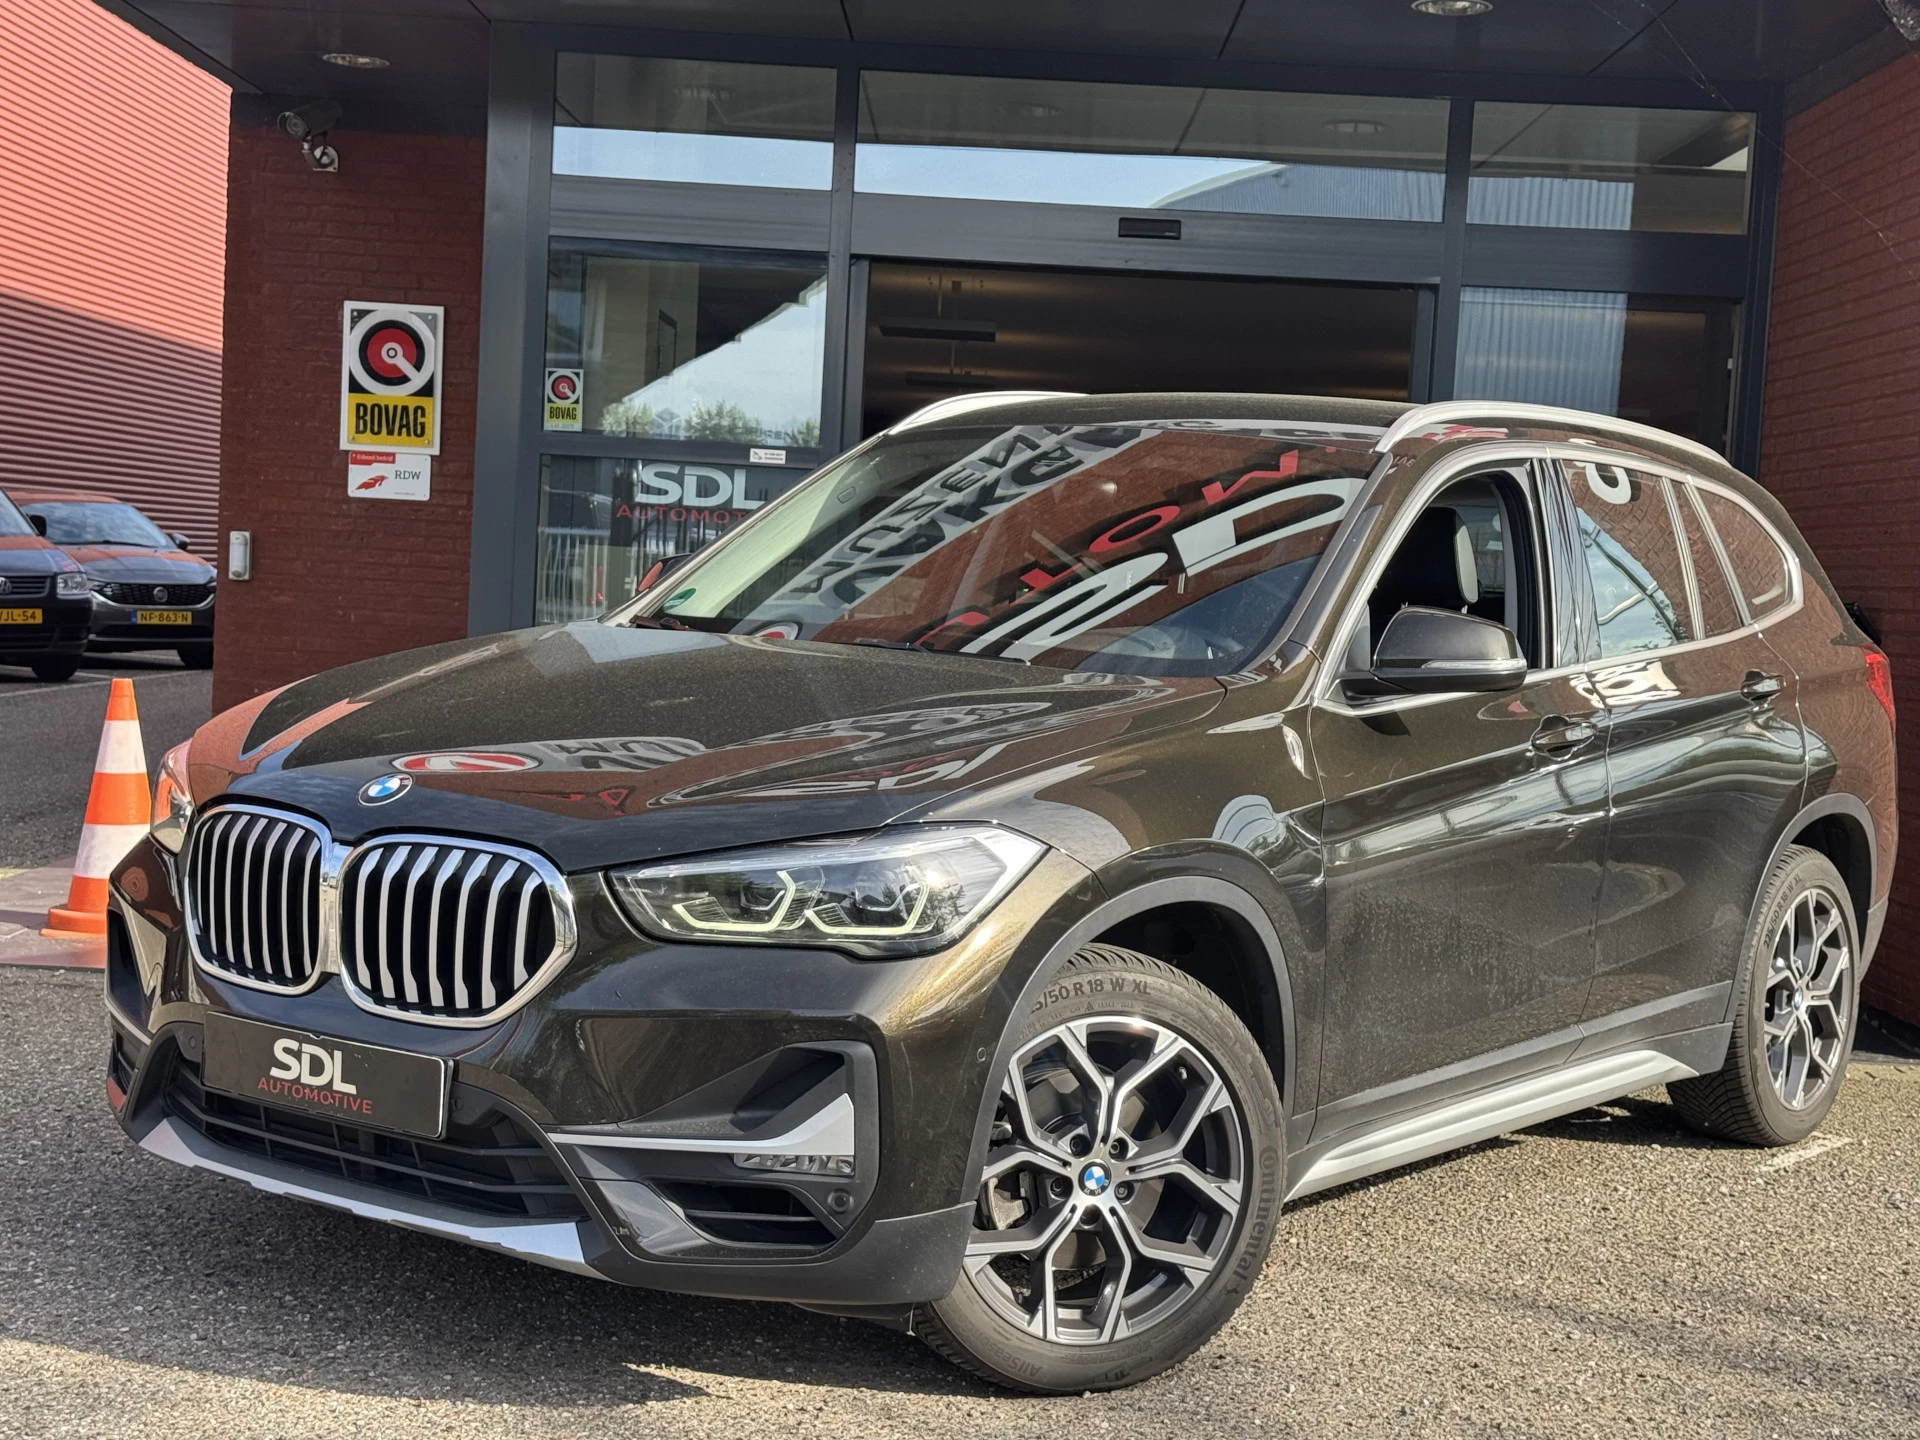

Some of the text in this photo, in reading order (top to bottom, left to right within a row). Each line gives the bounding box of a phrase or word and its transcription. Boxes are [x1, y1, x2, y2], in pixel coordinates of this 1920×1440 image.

[355, 402, 426, 438] BOVAG
[549, 406, 577, 420] BOVAG
[394, 470, 421, 480] RDW
[634, 463, 767, 510] SDL
[140, 612, 189, 623] NF-863-N
[1073, 981, 1085, 996] R
[1086, 978, 1104, 993] 18
[1110, 977, 1125, 991] W
[1131, 979, 1151, 995] XL
[269, 1038, 357, 1095] SDL
[257, 1077, 373, 1114] AUTOMOTIVE
[1233, 1146, 1278, 1281] Continental
